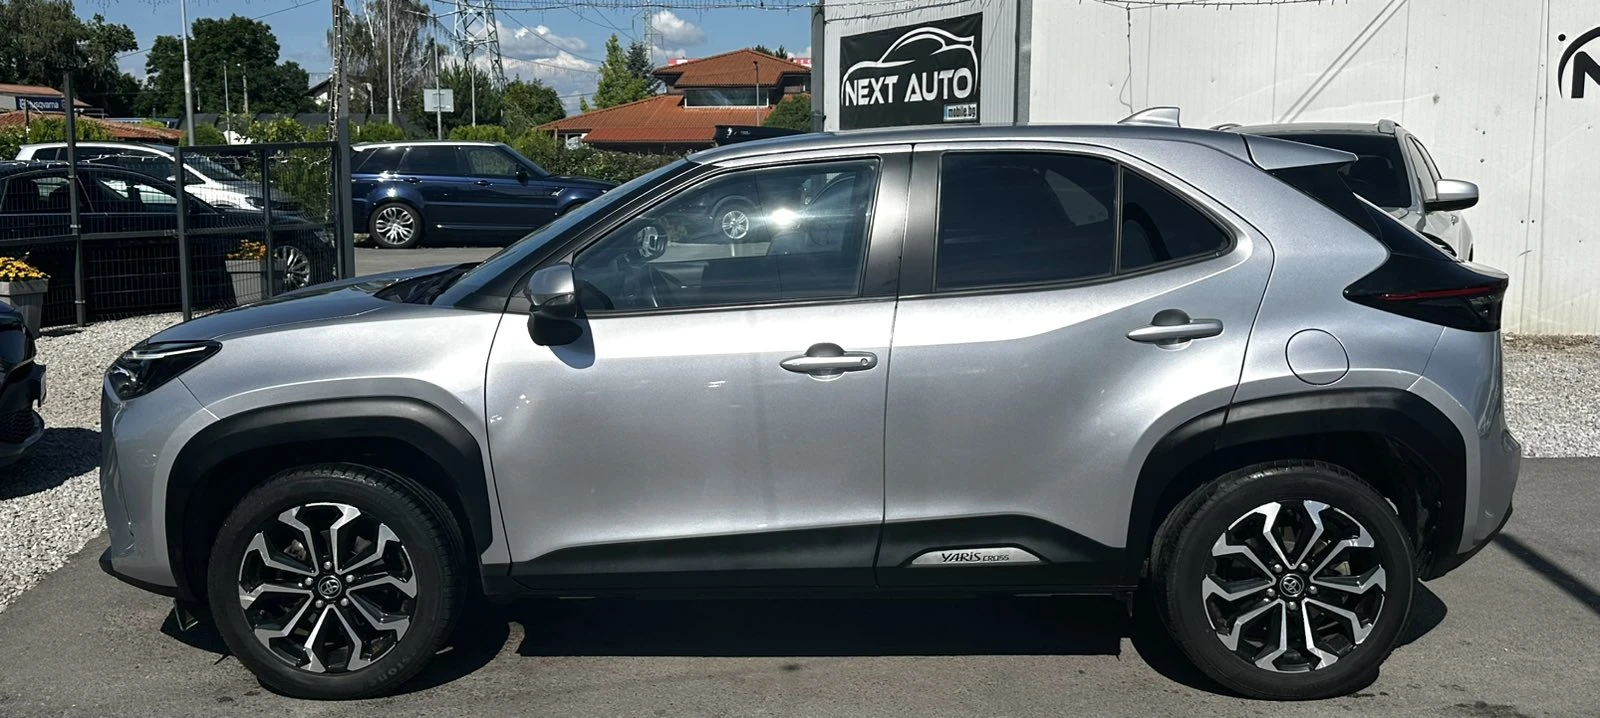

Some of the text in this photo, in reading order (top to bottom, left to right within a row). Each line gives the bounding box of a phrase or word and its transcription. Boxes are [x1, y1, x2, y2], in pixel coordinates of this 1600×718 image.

[845, 67, 973, 107] NEXT AUTO
[948, 105, 977, 118] mobile.bg
[982, 554, 1010, 562] CROSS
